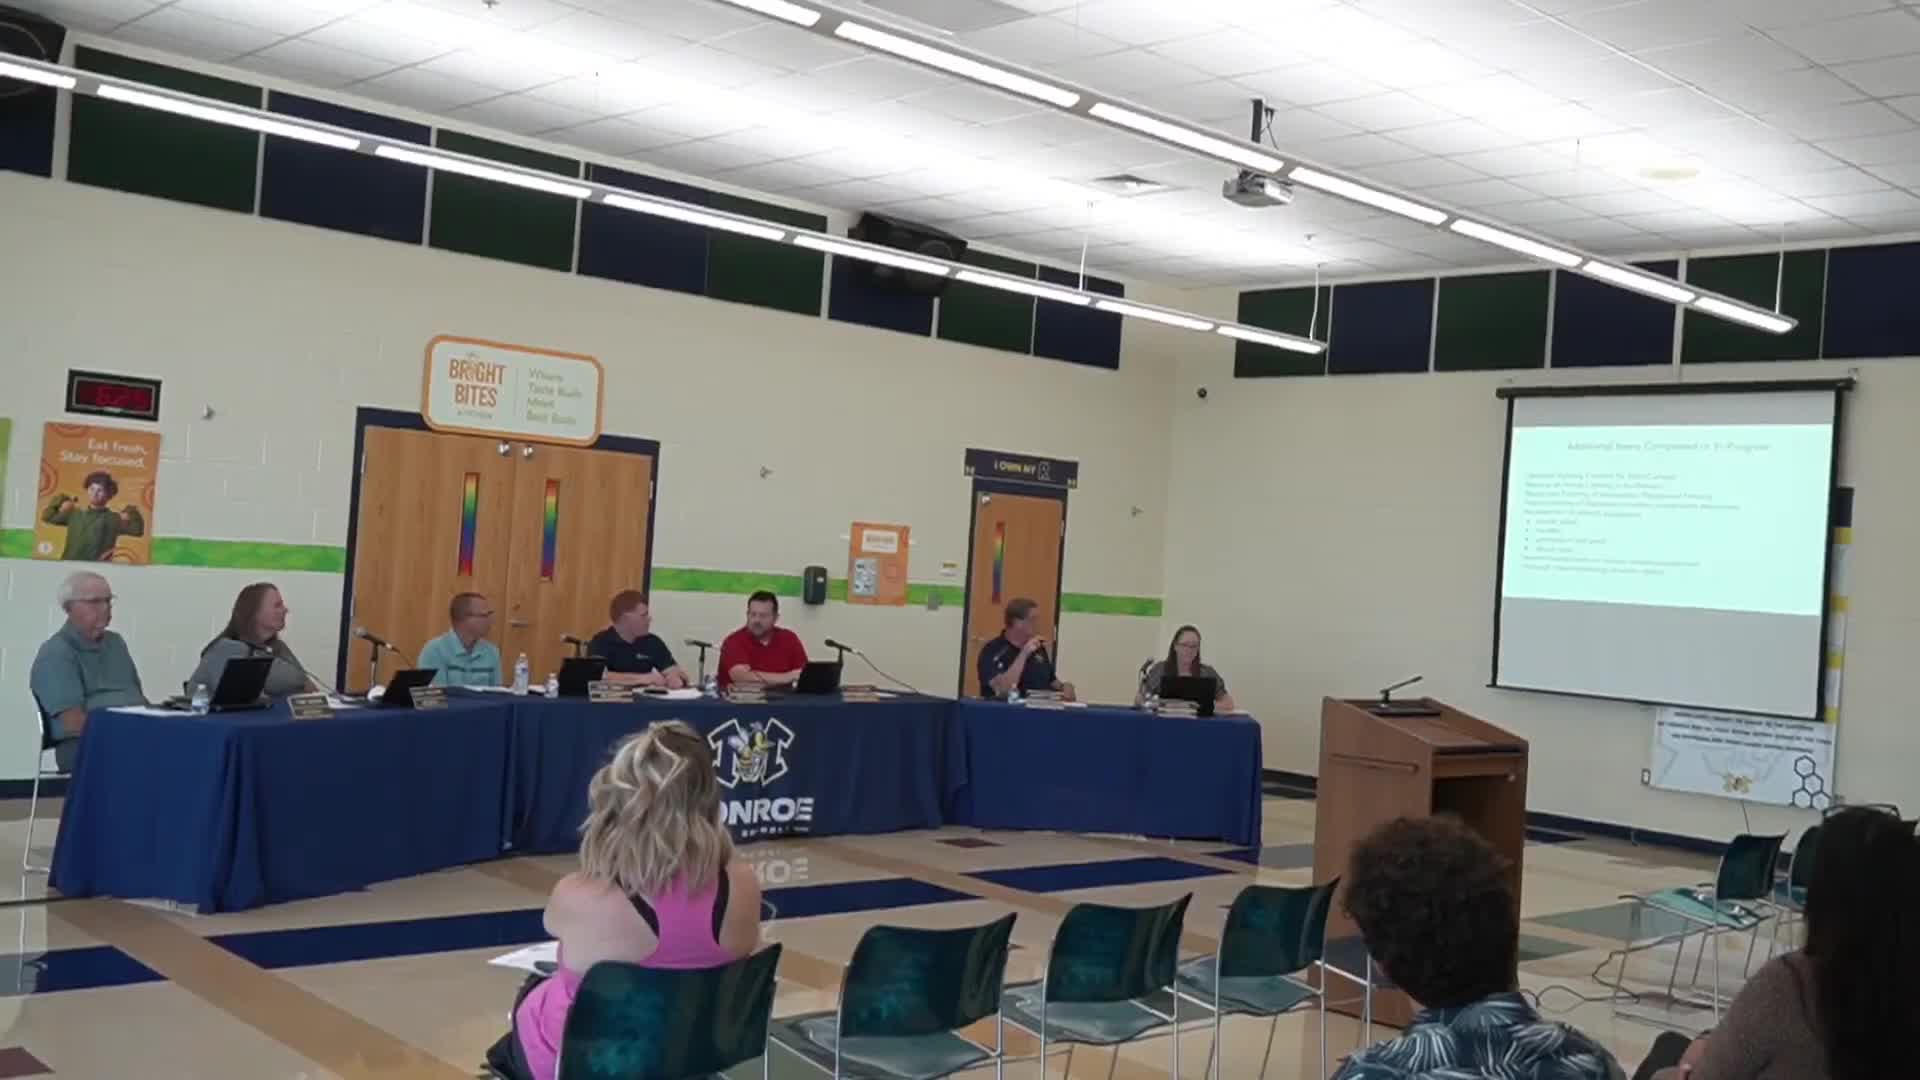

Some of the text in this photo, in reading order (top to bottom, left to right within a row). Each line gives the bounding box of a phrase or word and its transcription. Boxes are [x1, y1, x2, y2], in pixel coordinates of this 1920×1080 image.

[449, 358, 506, 384] BRIGHT
[454, 384, 497, 407] BITES
[61, 449, 89, 464] Stay
[87, 438, 108, 452] Eat
[719, 797, 814, 824] NROE
